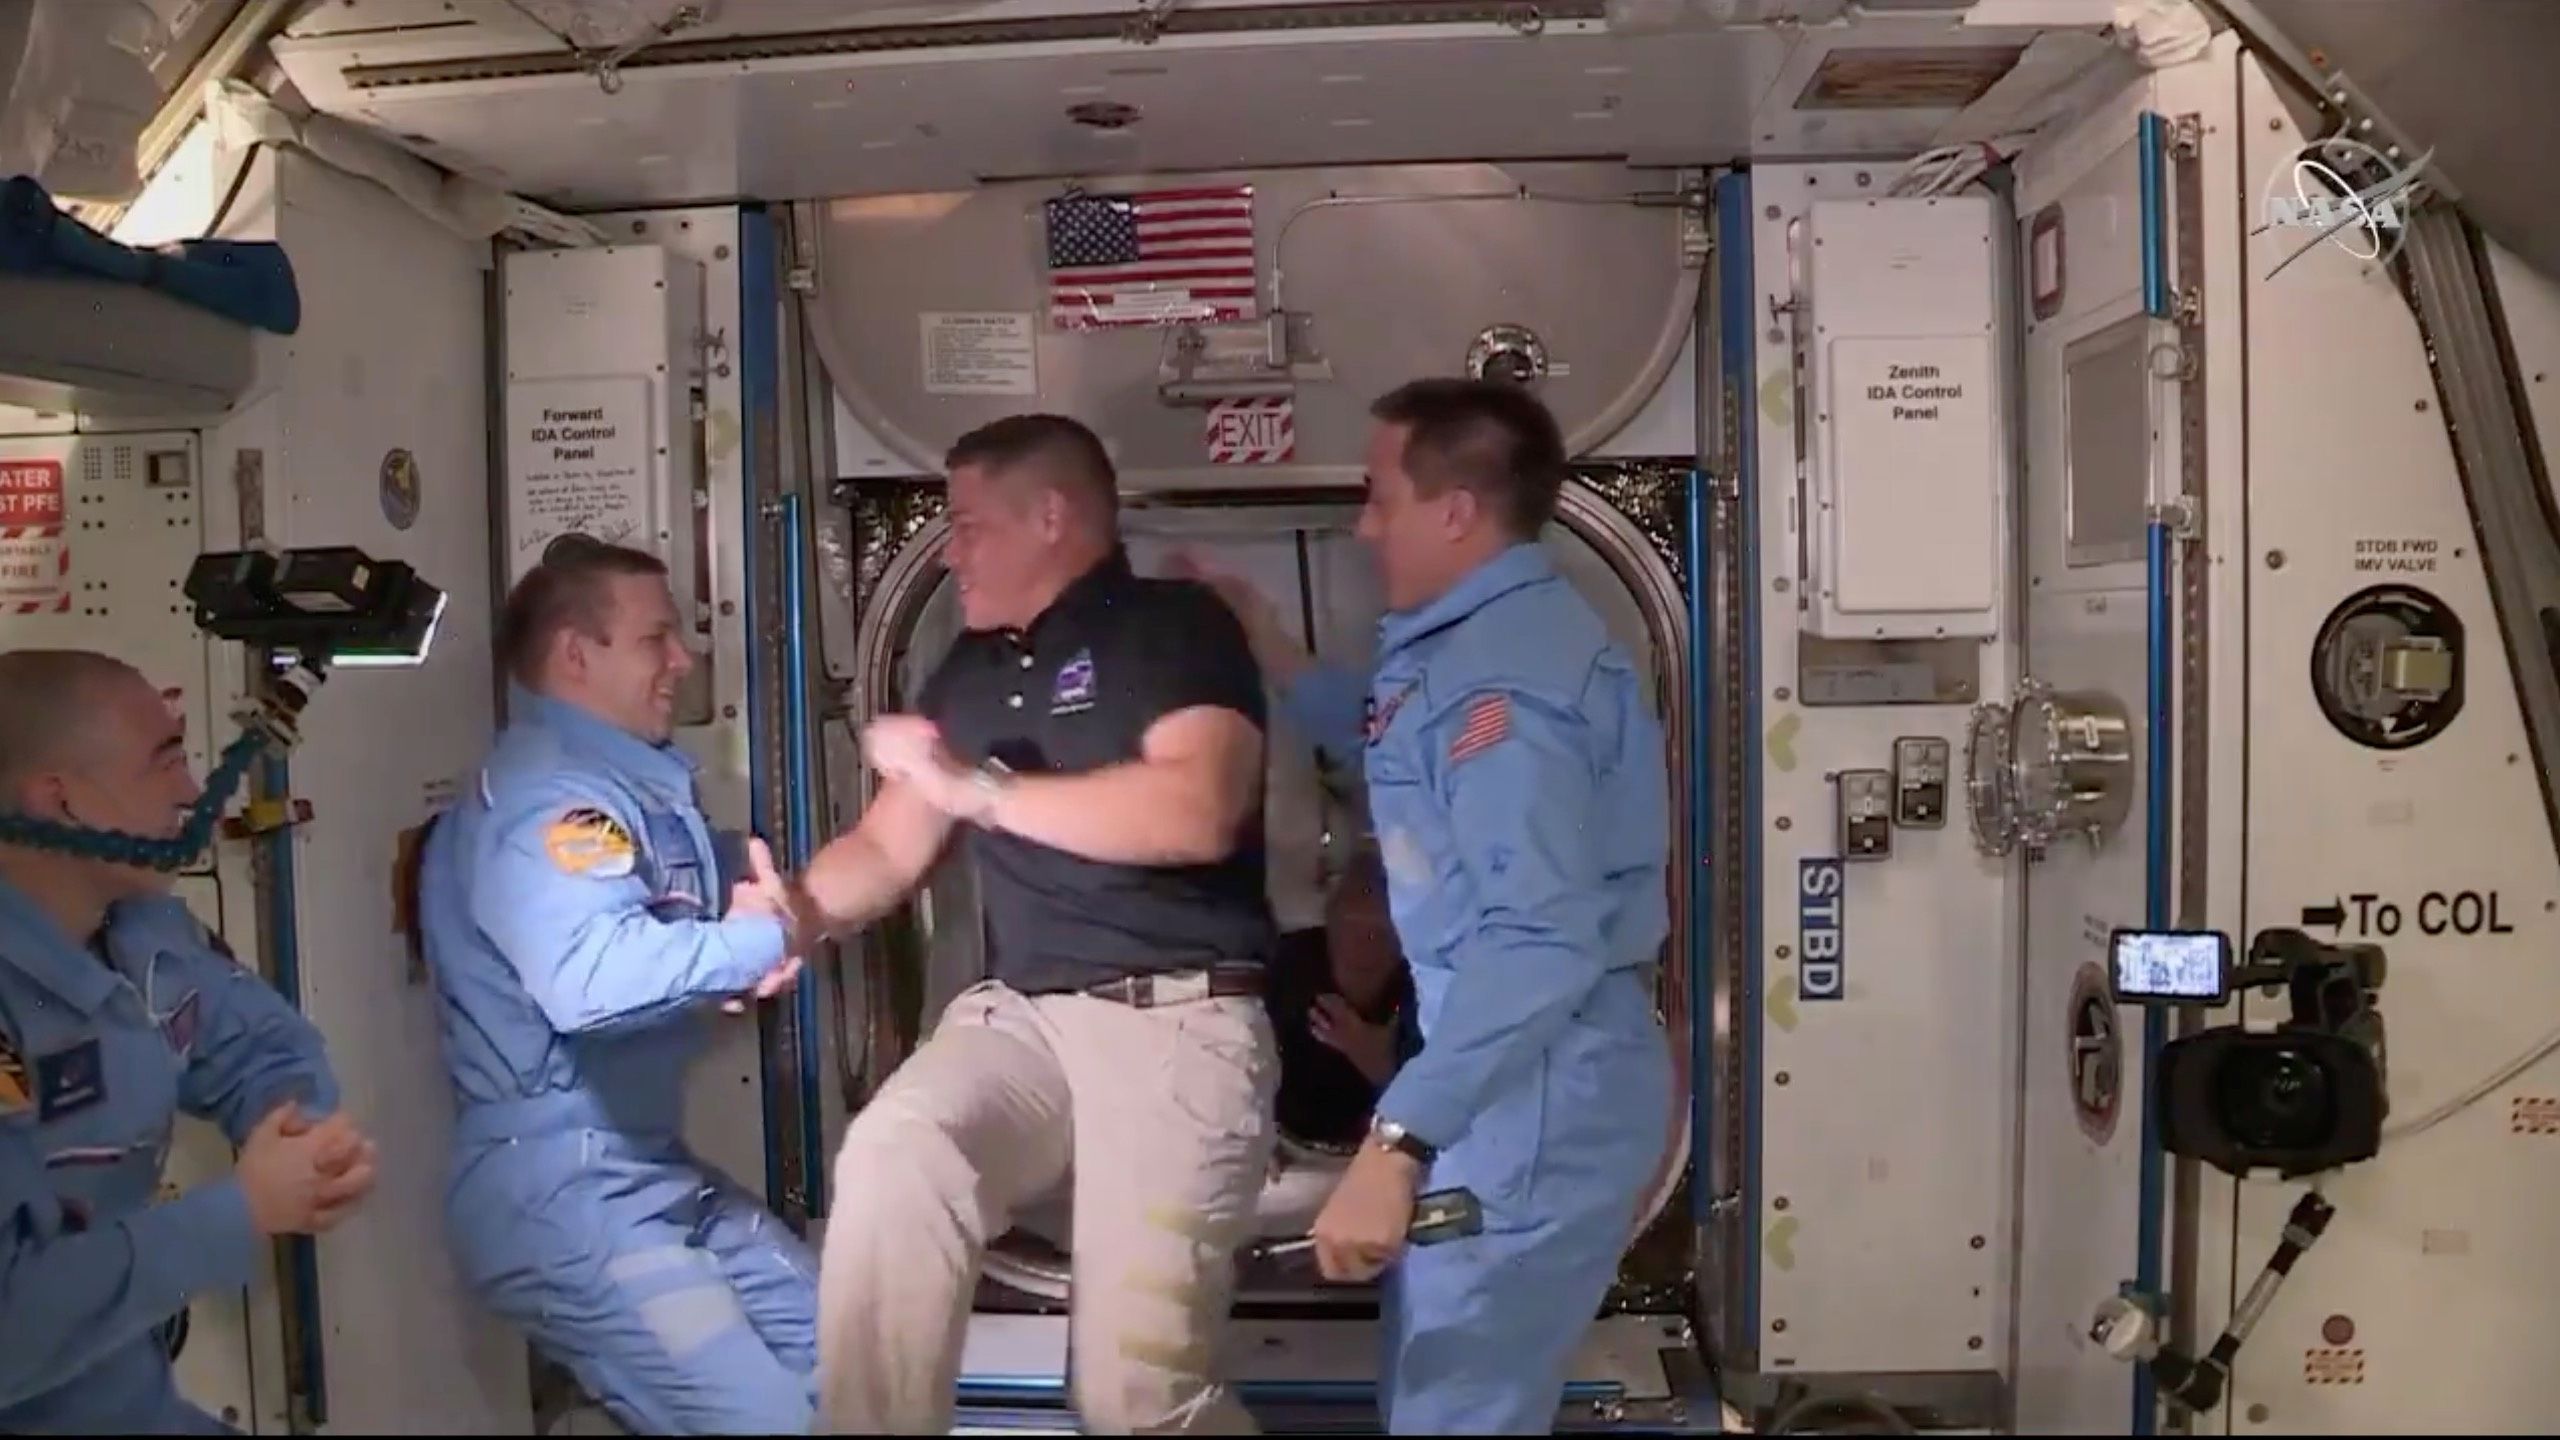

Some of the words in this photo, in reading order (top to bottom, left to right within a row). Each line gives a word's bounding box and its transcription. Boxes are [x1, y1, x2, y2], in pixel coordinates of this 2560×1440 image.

[1888, 364, 1940, 379] Zenith
[1867, 386, 1897, 399] IDA
[1902, 383, 1962, 399] Control
[544, 407, 603, 422] Forward
[1893, 405, 1938, 419] Panel
[532, 428, 557, 441] IDA
[562, 426, 615, 441] Control
[1220, 413, 1279, 447] EXIT
[554, 446, 595, 461] Panel
[23, 493, 59, 511] PFE
[2402, 540, 2438, 552] FWD
[2, 565, 39, 579] FIRE
[2355, 559, 2383, 571] IMV
[2387, 559, 2437, 571] VALVE
[2350, 894, 2402, 936] To
[2418, 891, 2514, 936] COL
[1802, 865, 1841, 995] STBD
